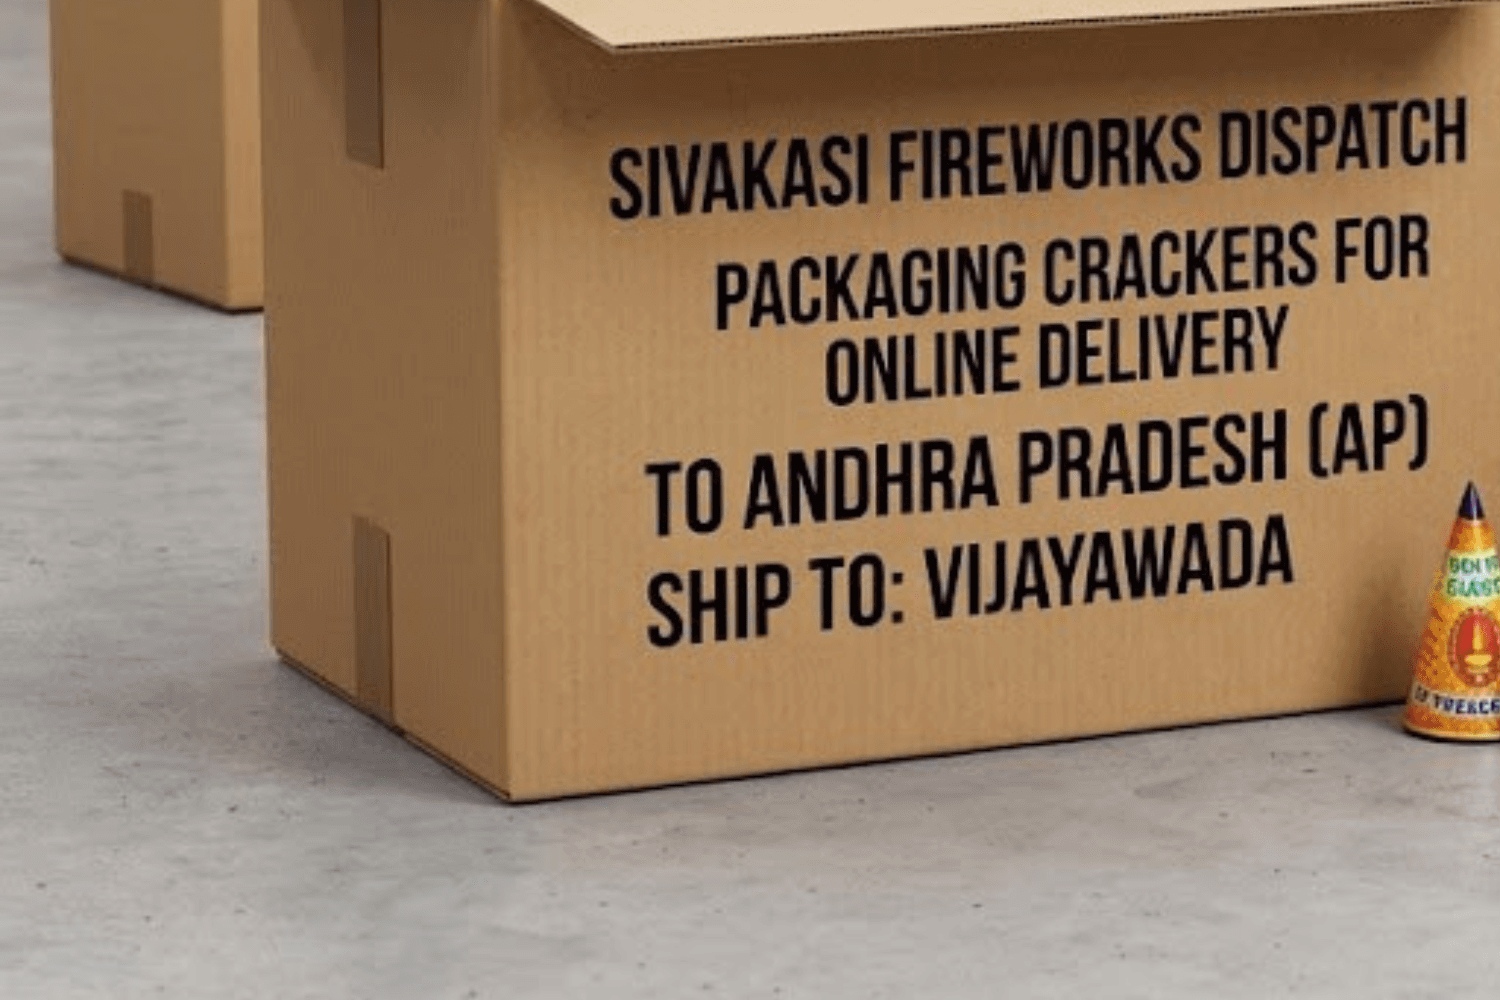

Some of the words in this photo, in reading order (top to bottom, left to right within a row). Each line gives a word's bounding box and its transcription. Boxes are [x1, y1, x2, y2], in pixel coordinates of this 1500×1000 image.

[608, 133, 870, 221] SIVAKASI
[888, 113, 1204, 204] FIREWORKS
[1218, 96, 1469, 180] DISPATCH
[714, 241, 1026, 331] PACKAGING
[1043, 221, 1318, 306] CRACKERS
[1334, 213, 1430, 286] FOR
[825, 326, 1020, 406] ONLINE
[1038, 305, 1290, 390] DELIVERY
[645, 458, 723, 538] TO
[743, 437, 998, 532] ANDHRA
[1018, 408, 1289, 505] PRADESH
[1308, 393, 1431, 481] (AP)
[646, 563, 791, 651] SHIP
[807, 553, 905, 633] TO:
[924, 514, 1295, 621] VIJAYAWADA
